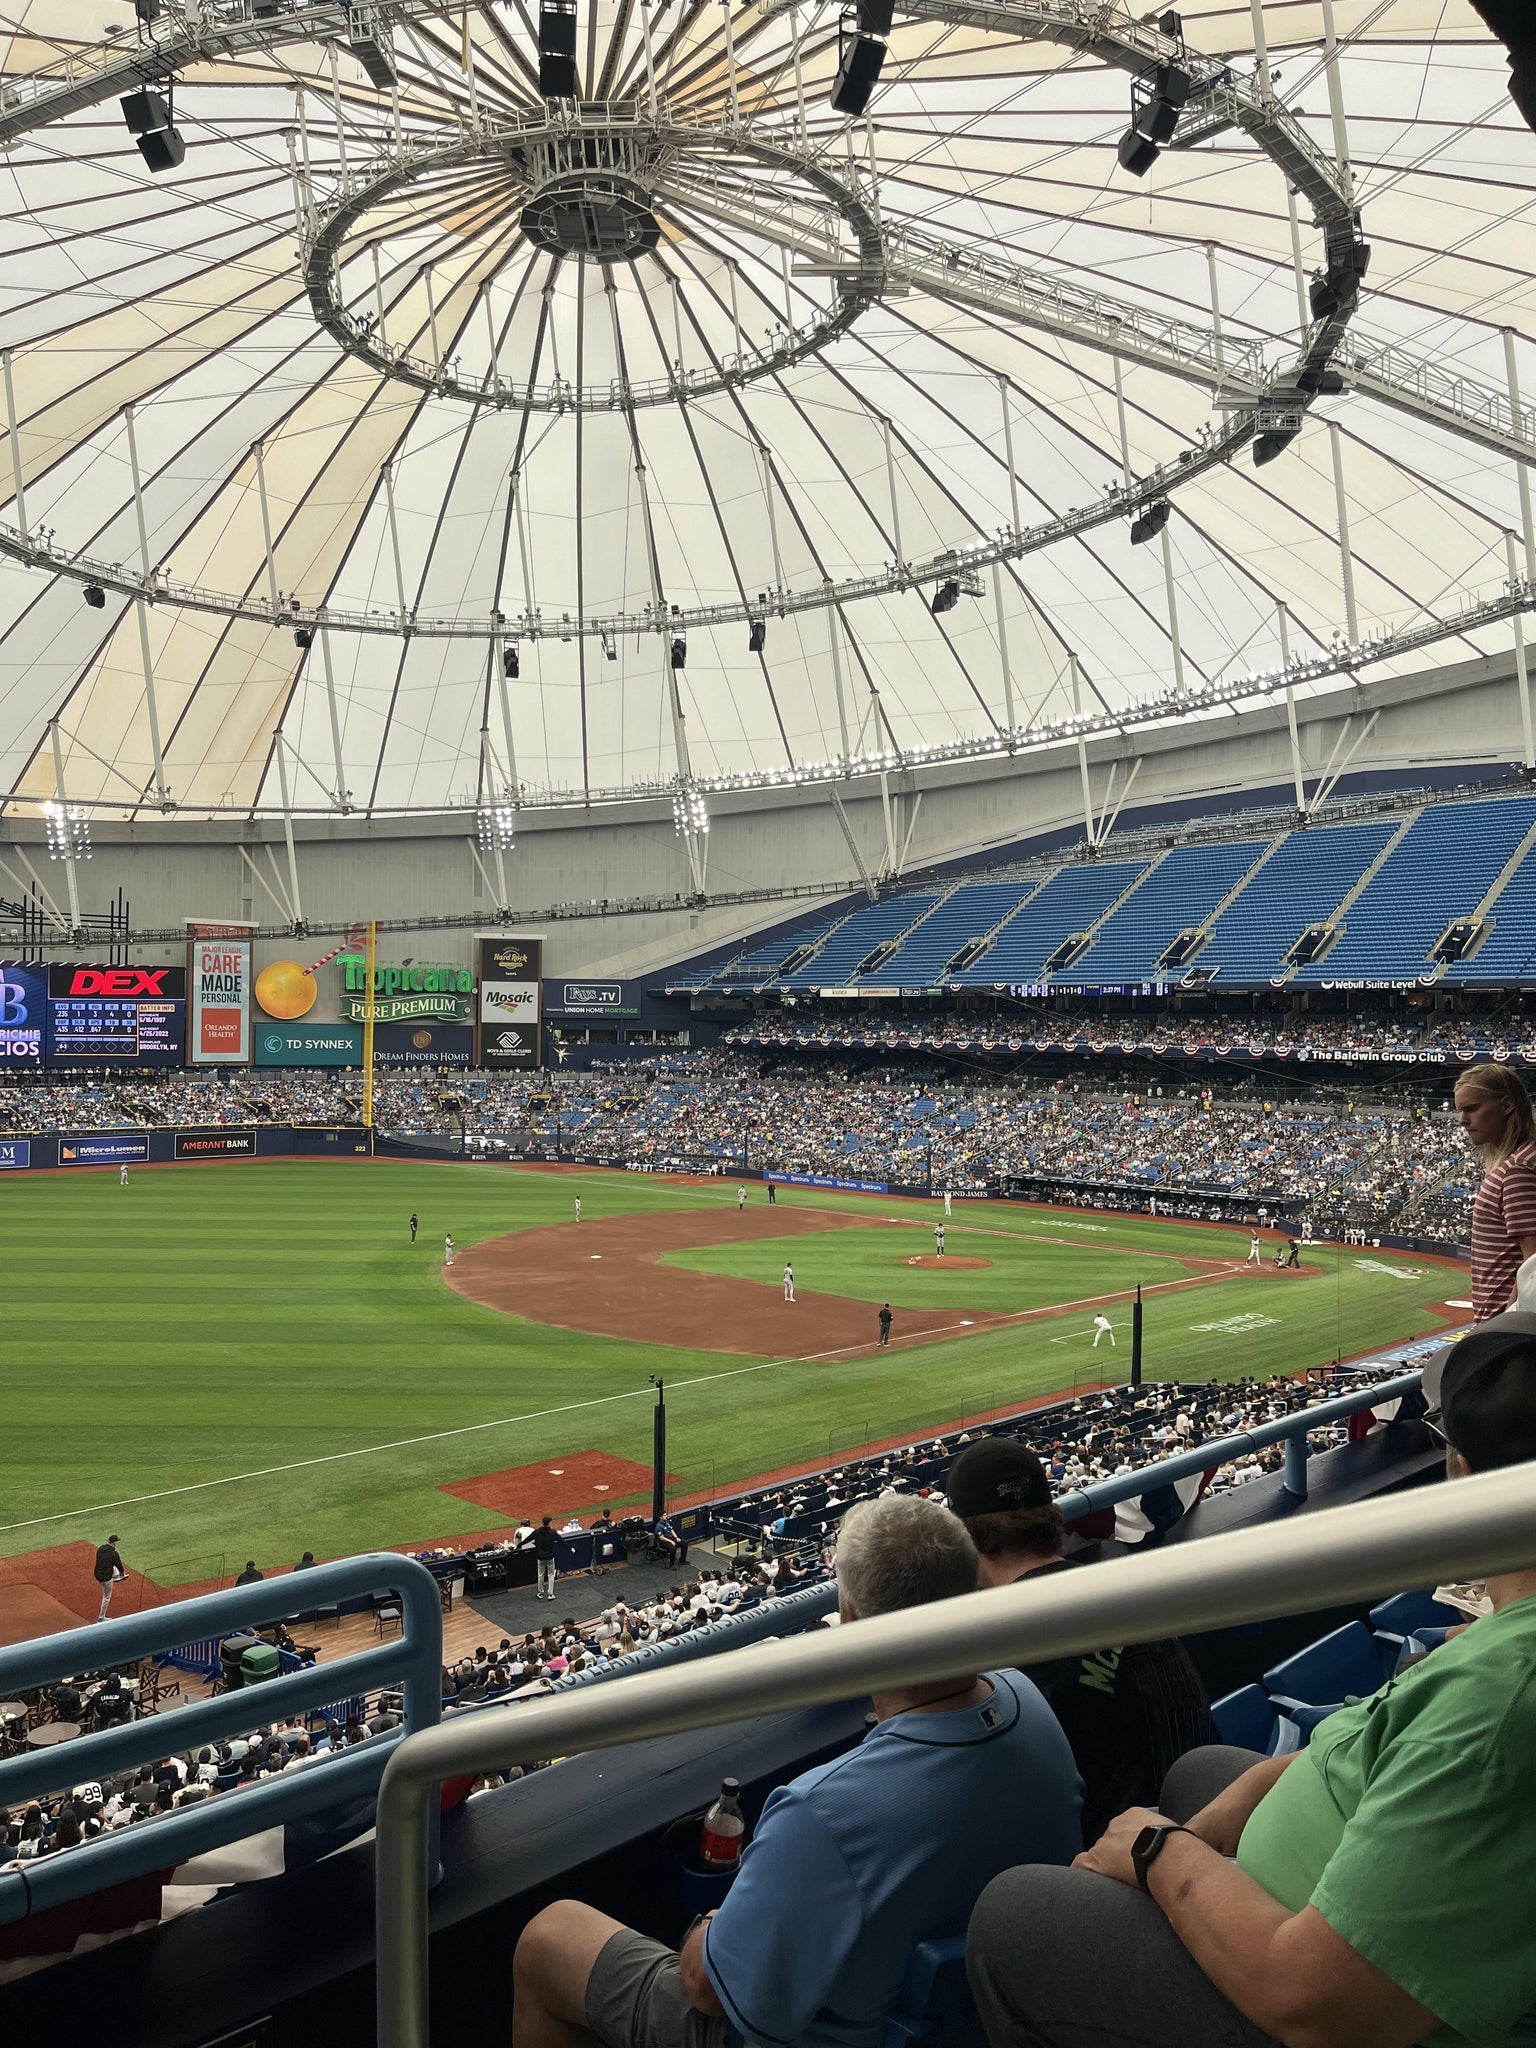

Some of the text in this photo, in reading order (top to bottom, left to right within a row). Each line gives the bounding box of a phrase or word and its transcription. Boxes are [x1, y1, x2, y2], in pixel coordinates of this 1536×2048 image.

[494, 953, 528, 962] Hard Rock
[202, 954, 242, 974] CARE
[336, 954, 472, 995] Tropicana
[70, 970, 168, 995] DEX
[202, 974, 242, 992] MADE
[1392, 980, 1416, 988] Level
[202, 993, 242, 1003] PERSONAL
[486, 992, 534, 1003] Mosaic
[599, 992, 616, 1001] .TV
[352, 999, 456, 1018] PURE PREMIUM
[0, 1030, 40, 1039] RICHIE
[286, 1040, 353, 1049] TD SYNNEX
[373, 1052, 469, 1061] DREAM FINDERS HOMES
[1312, 1051, 1446, 1063] The Baldwin Group Club
[182, 1140, 249, 1150] AMERANT BANK
[1079, 1646, 1124, 1694] MC
[85, 1786, 101, 1801] 99
